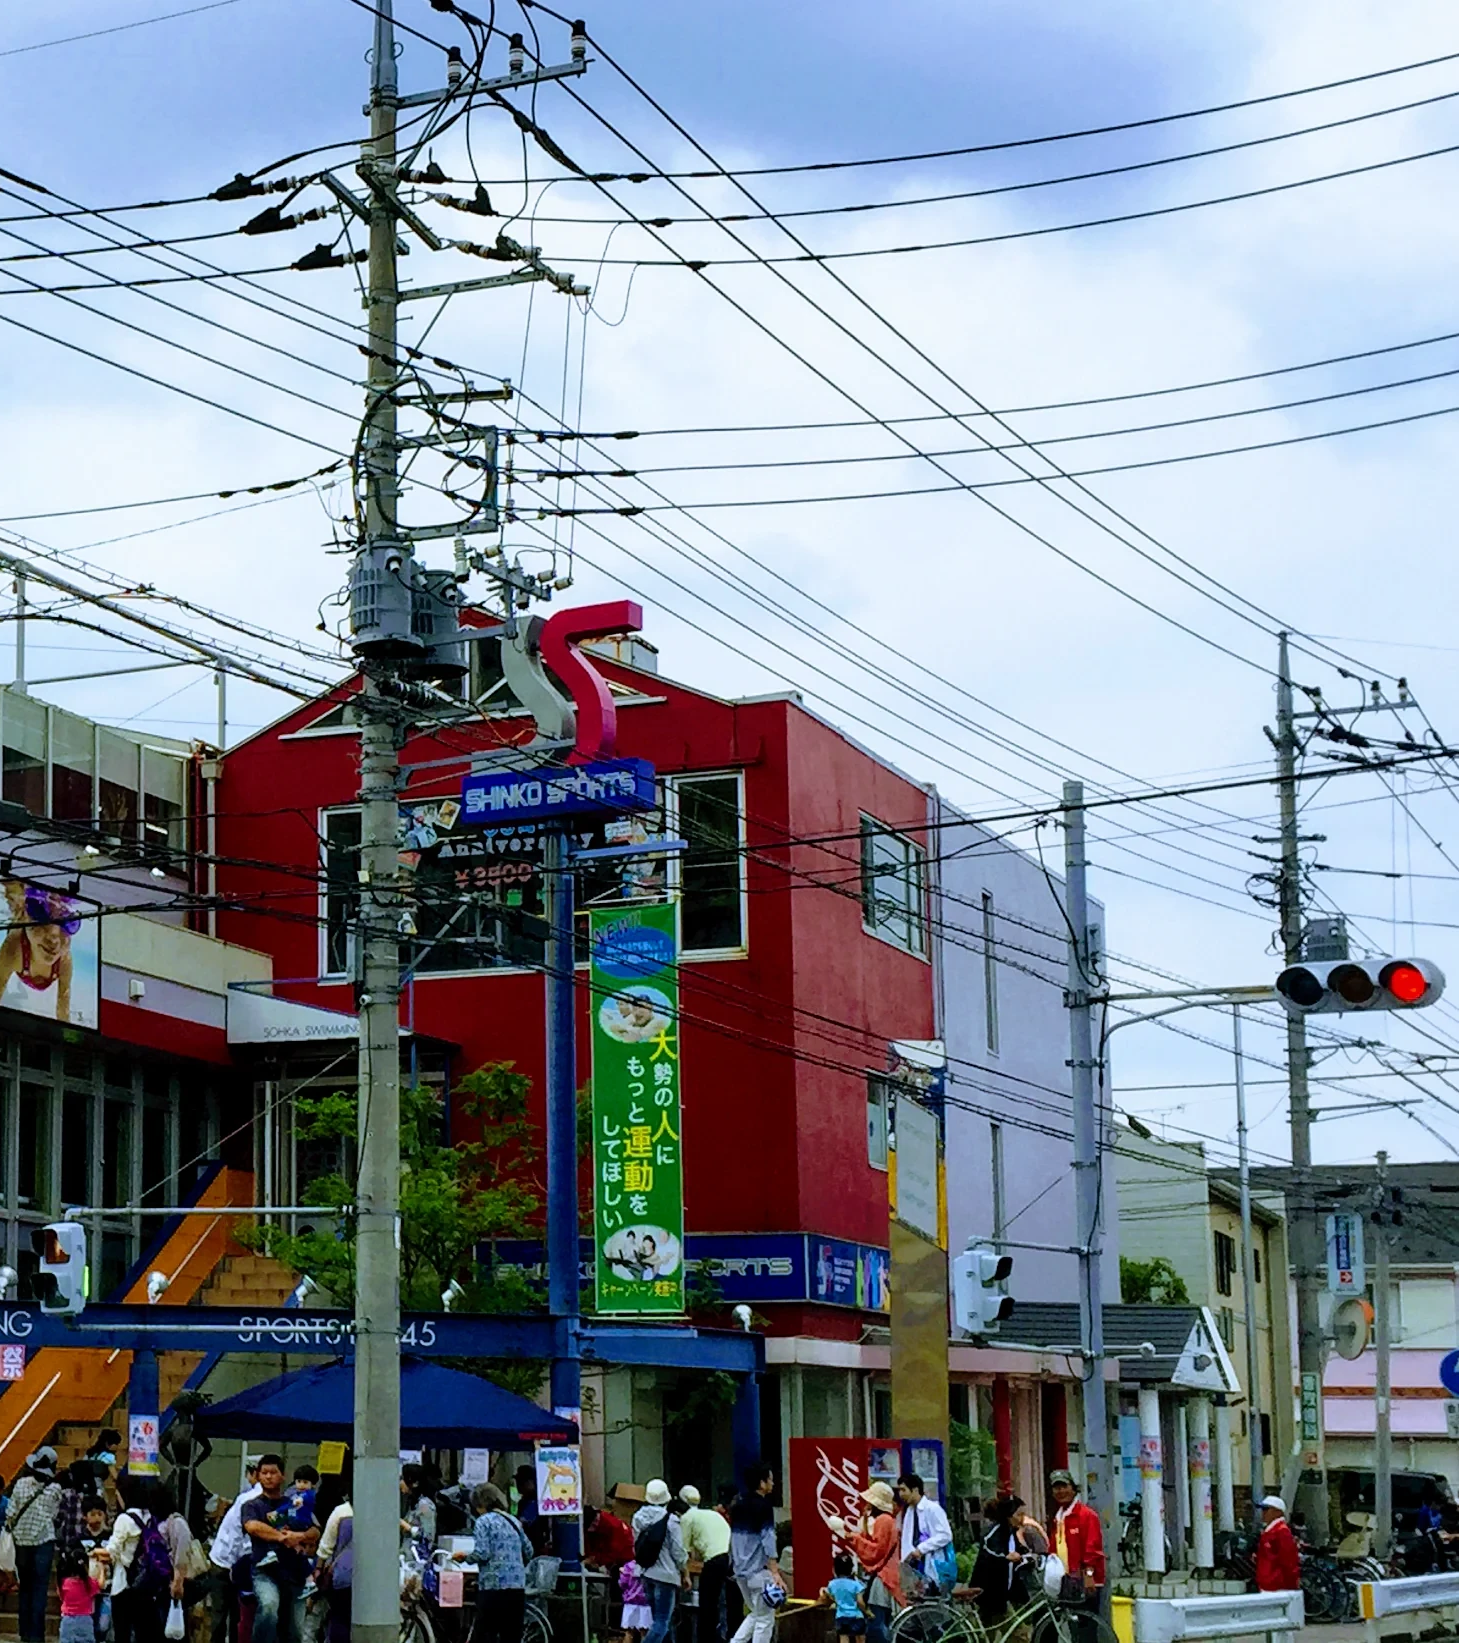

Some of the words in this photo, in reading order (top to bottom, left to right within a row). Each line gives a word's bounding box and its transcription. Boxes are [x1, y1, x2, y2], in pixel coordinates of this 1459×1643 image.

[465, 781, 542, 813] SHINKO
[546, 770, 636, 805] SPORTS
[263, 1026, 300, 1038] SOHKA
[623, 1056, 653, 1216] もっと運動を
[649, 1029, 679, 1165] 大勢の人に
[602, 1115, 623, 1228] してほしい
[238, 1316, 341, 1344] SPORTS
